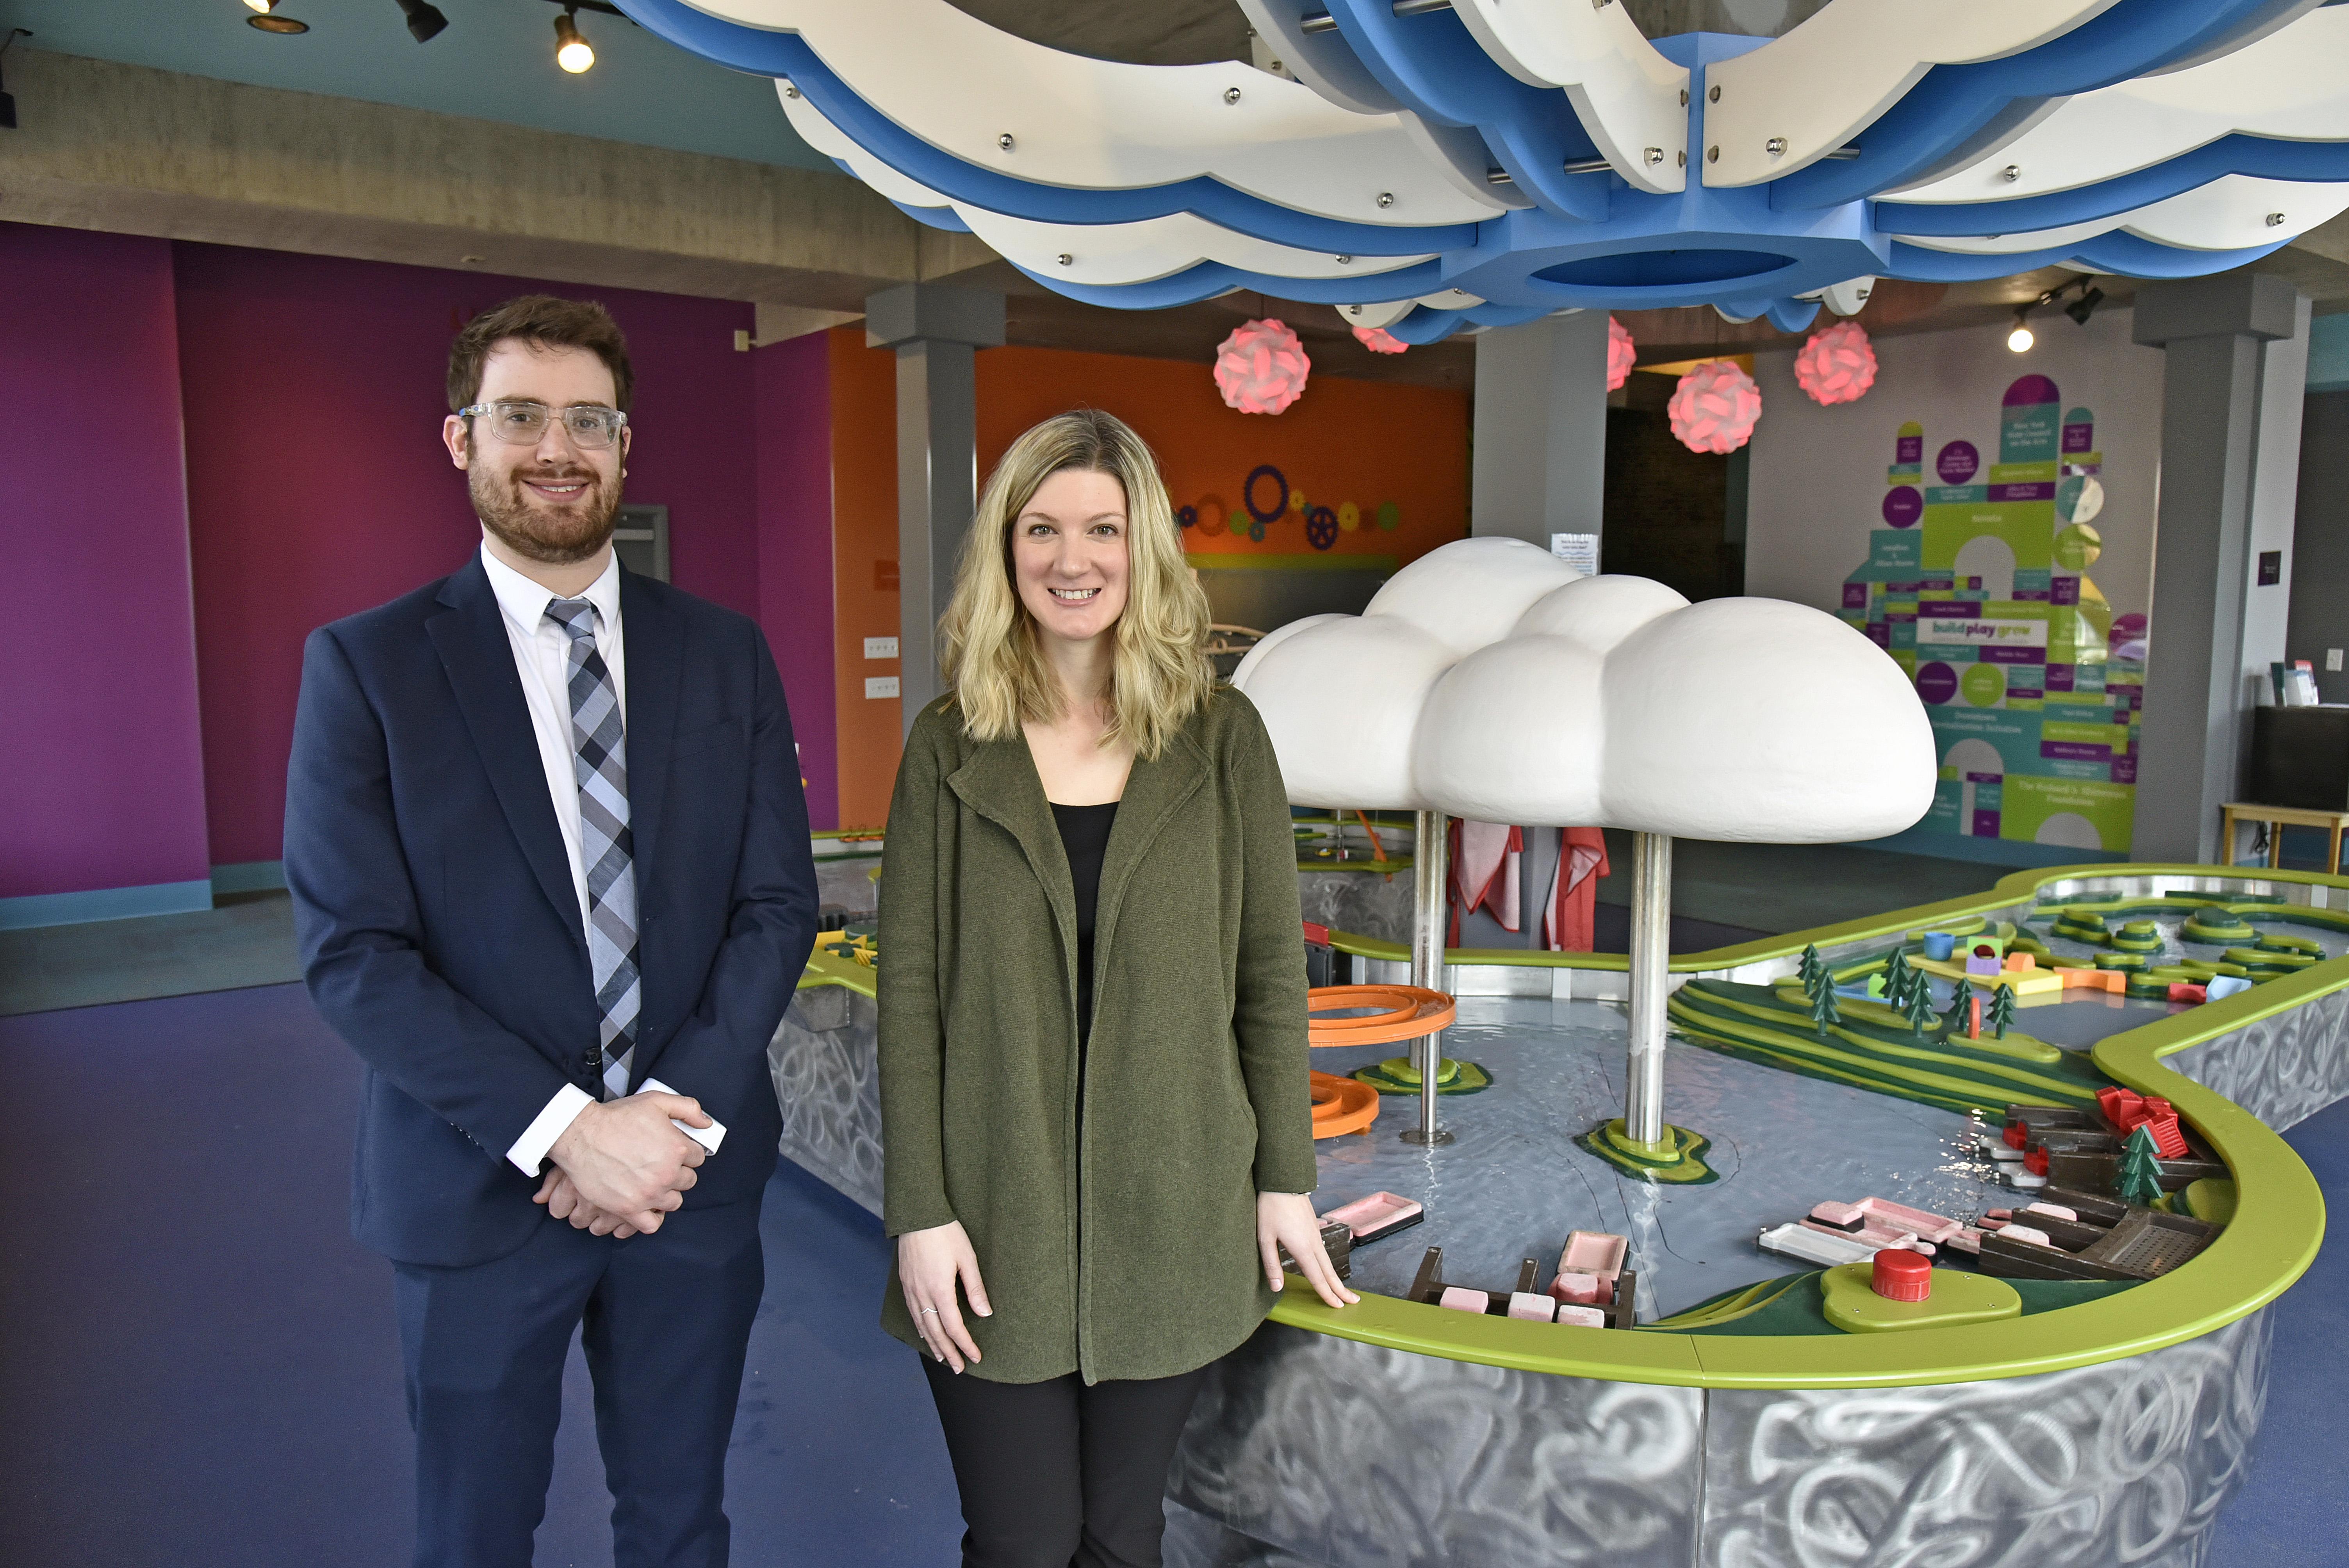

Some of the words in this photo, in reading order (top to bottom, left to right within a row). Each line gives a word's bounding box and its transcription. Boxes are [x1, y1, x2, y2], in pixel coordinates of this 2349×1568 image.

[1934, 621, 1964, 633] build
[1966, 622, 1995, 638] play
[1998, 626, 2030, 638] grow
